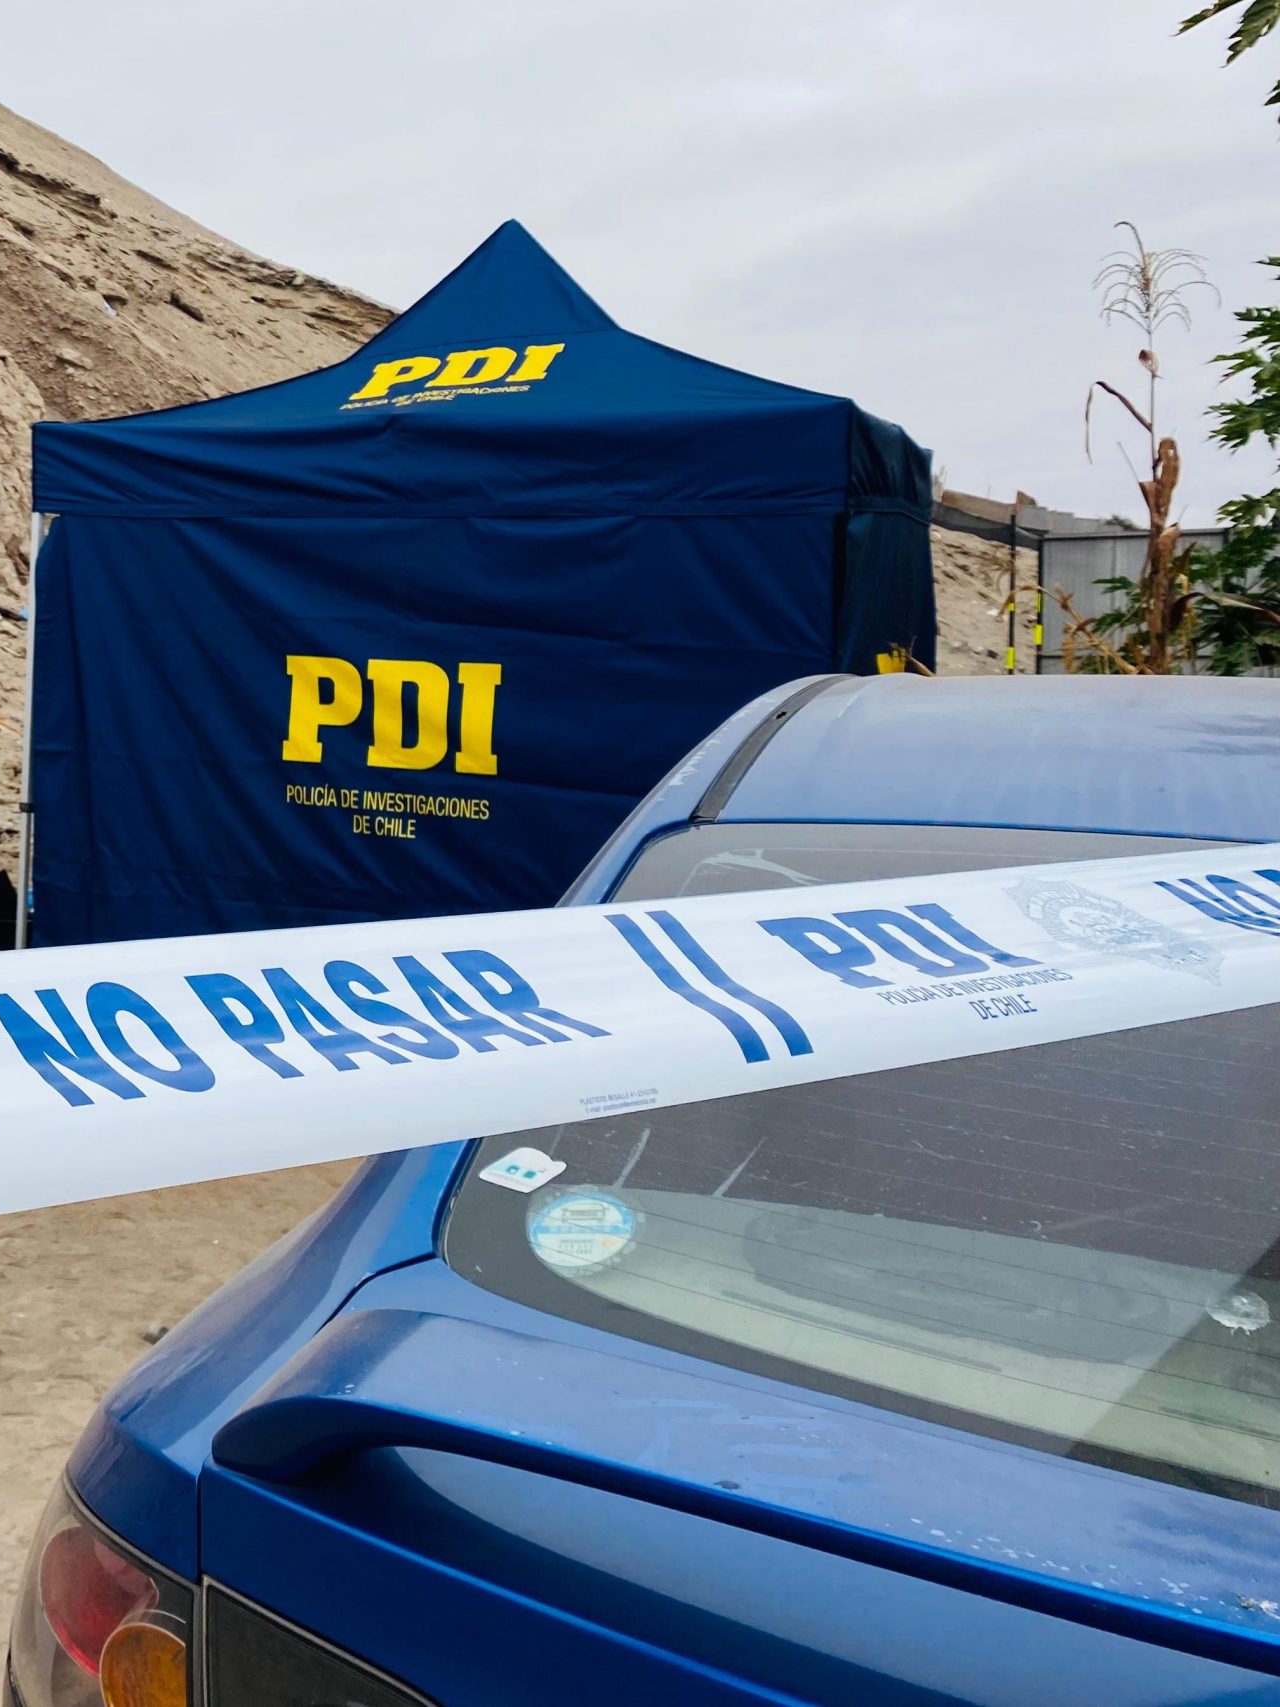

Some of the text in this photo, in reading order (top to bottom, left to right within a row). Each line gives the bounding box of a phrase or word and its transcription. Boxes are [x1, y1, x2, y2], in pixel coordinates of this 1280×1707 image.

[349, 343, 565, 400] PDI
[282, 654, 502, 775] PDI
[286, 784, 490, 820] POLICÍA DE INVESTIGACIONES
[353, 814, 417, 839] DE CHILE
[756, 902, 1044, 989] PDI
[930, 983, 963, 999] DE
[951, 968, 1074, 995] INVESTIGACIONES
[184, 949, 613, 1079] PASAR
[969, 994, 1038, 1020] DE CHILE
